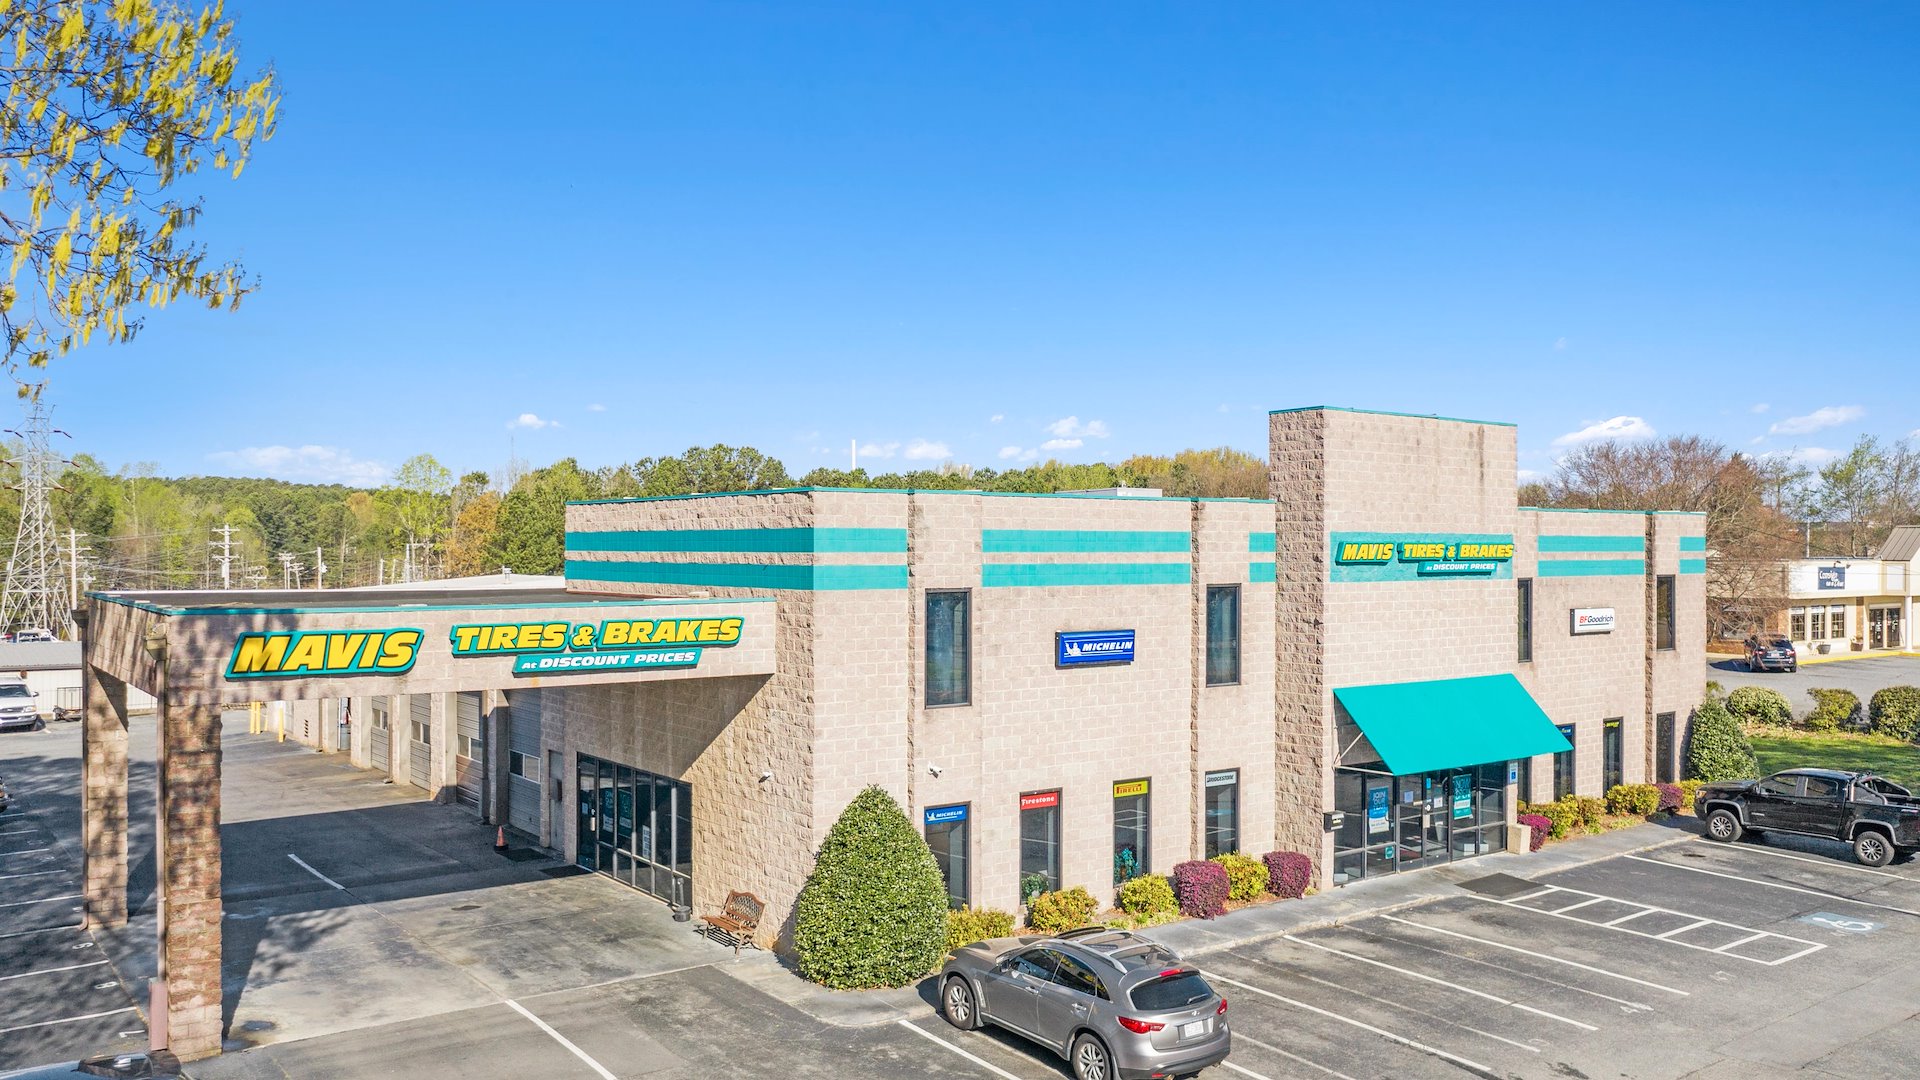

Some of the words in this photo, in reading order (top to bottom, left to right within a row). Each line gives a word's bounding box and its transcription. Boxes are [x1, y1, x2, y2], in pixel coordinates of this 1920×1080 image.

[1342, 543, 1394, 560] MAVIS
[1403, 543, 1445, 558] TIRES
[1446, 545, 1456, 558] &
[1460, 544, 1514, 558] BRAKES
[1433, 563, 1469, 571] DISCOUNT
[1579, 615, 1613, 624] BFGoodrich
[232, 632, 419, 673] MAVIS
[456, 624, 568, 650] TIRES
[571, 626, 594, 647] &
[602, 619, 742, 645] BRAKES
[1082, 641, 1133, 652] MICHELIN
[539, 655, 630, 669] DISCOUNT
[634, 652, 696, 664] PRICES
[1021, 796, 1055, 806] Firestone
[936, 810, 963, 818] MICHELIN
